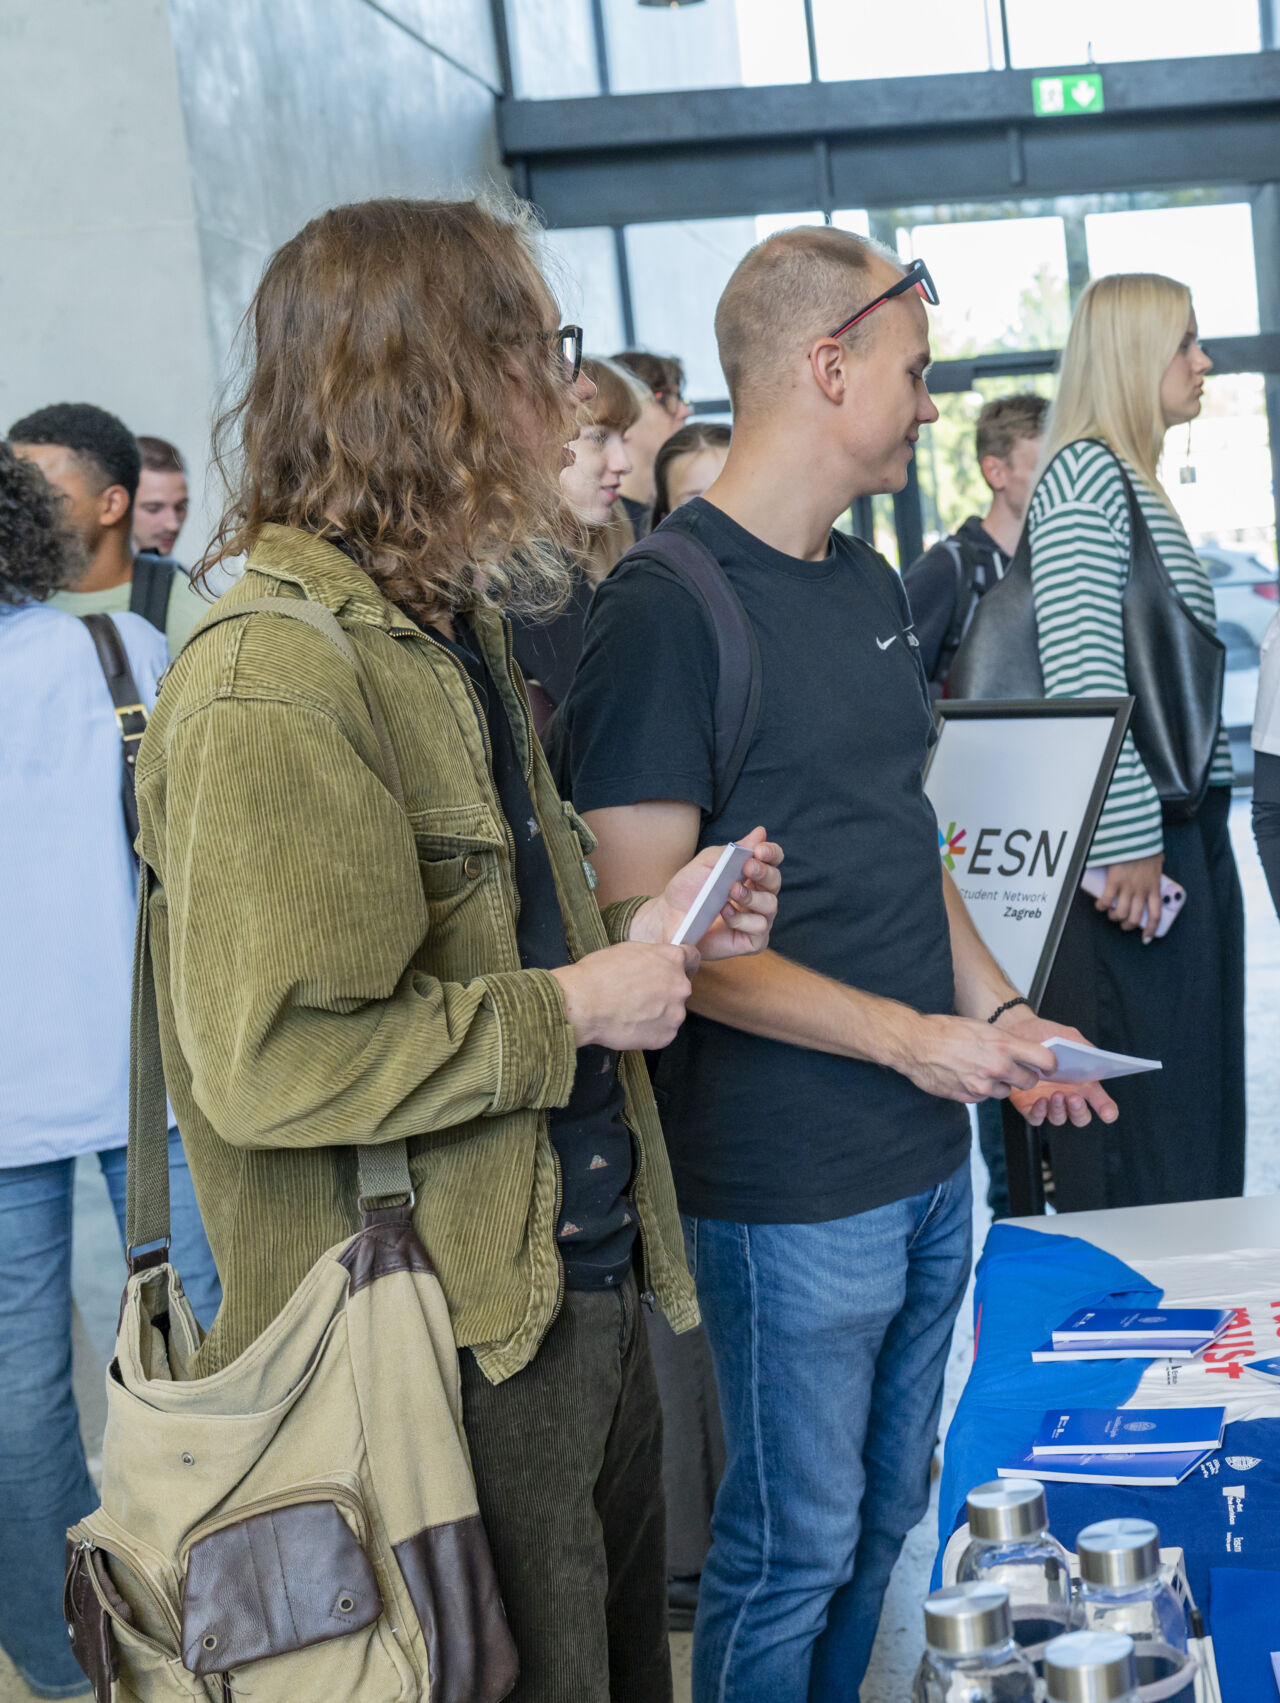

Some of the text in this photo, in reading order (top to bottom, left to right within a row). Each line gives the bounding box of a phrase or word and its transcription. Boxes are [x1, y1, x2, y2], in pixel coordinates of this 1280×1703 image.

[967, 828, 1068, 877] ESN
[1002, 890, 1048, 903] Network
[1003, 906, 1042, 921] Zagreb
